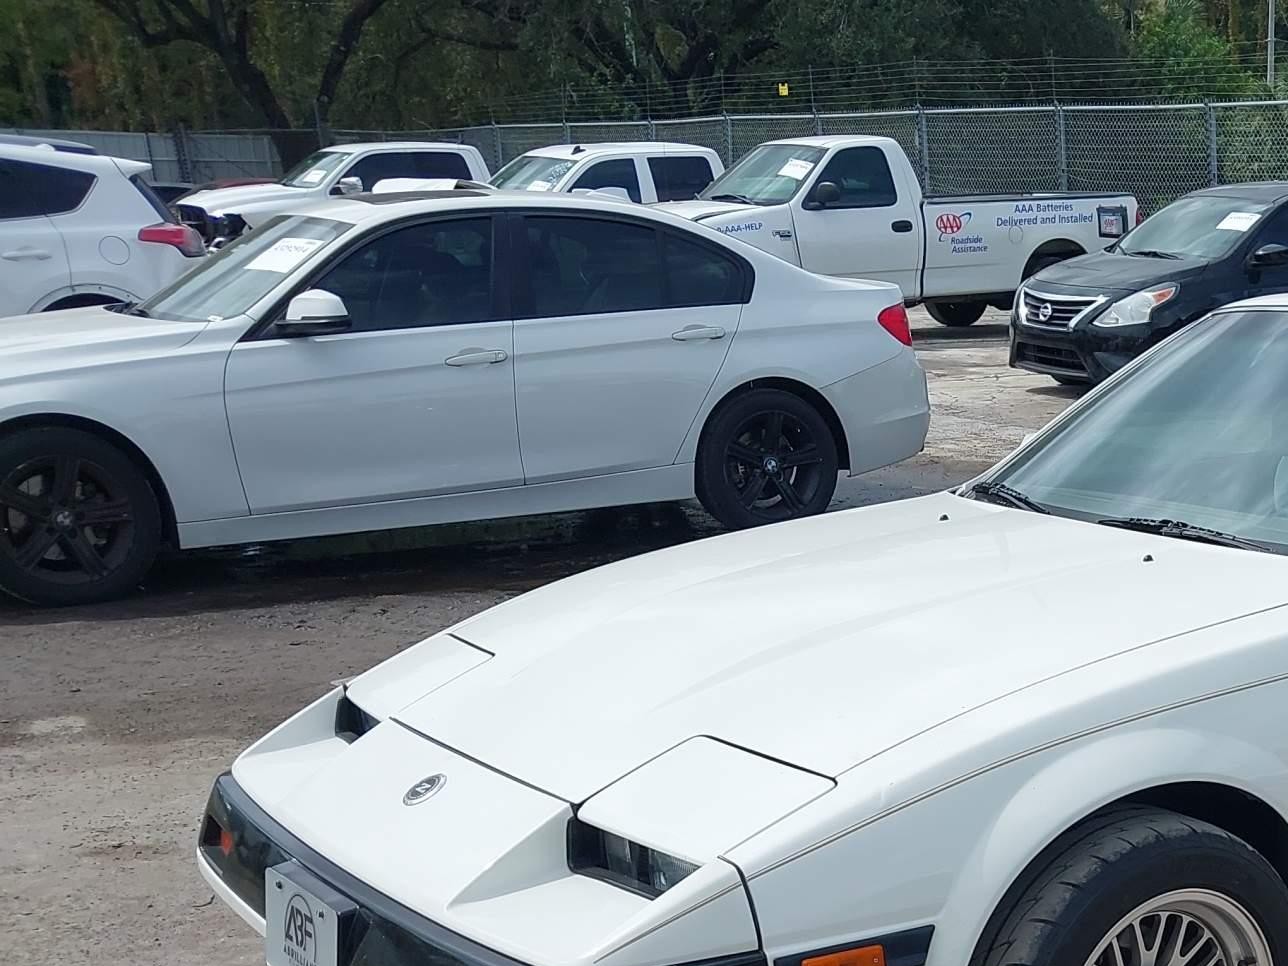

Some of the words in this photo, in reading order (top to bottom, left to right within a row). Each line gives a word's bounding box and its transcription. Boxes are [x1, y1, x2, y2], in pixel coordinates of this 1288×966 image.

[1014, 203, 1034, 214] AAA
[1036, 202, 1074, 213] Batteries
[939, 214, 961, 233] AAA
[996, 216, 1038, 227] Delivered
[1039, 214, 1057, 225] and
[1058, 213, 1094, 224] Installed
[951, 234, 983, 245] Roadside
[952, 245, 988, 254] Assistance
